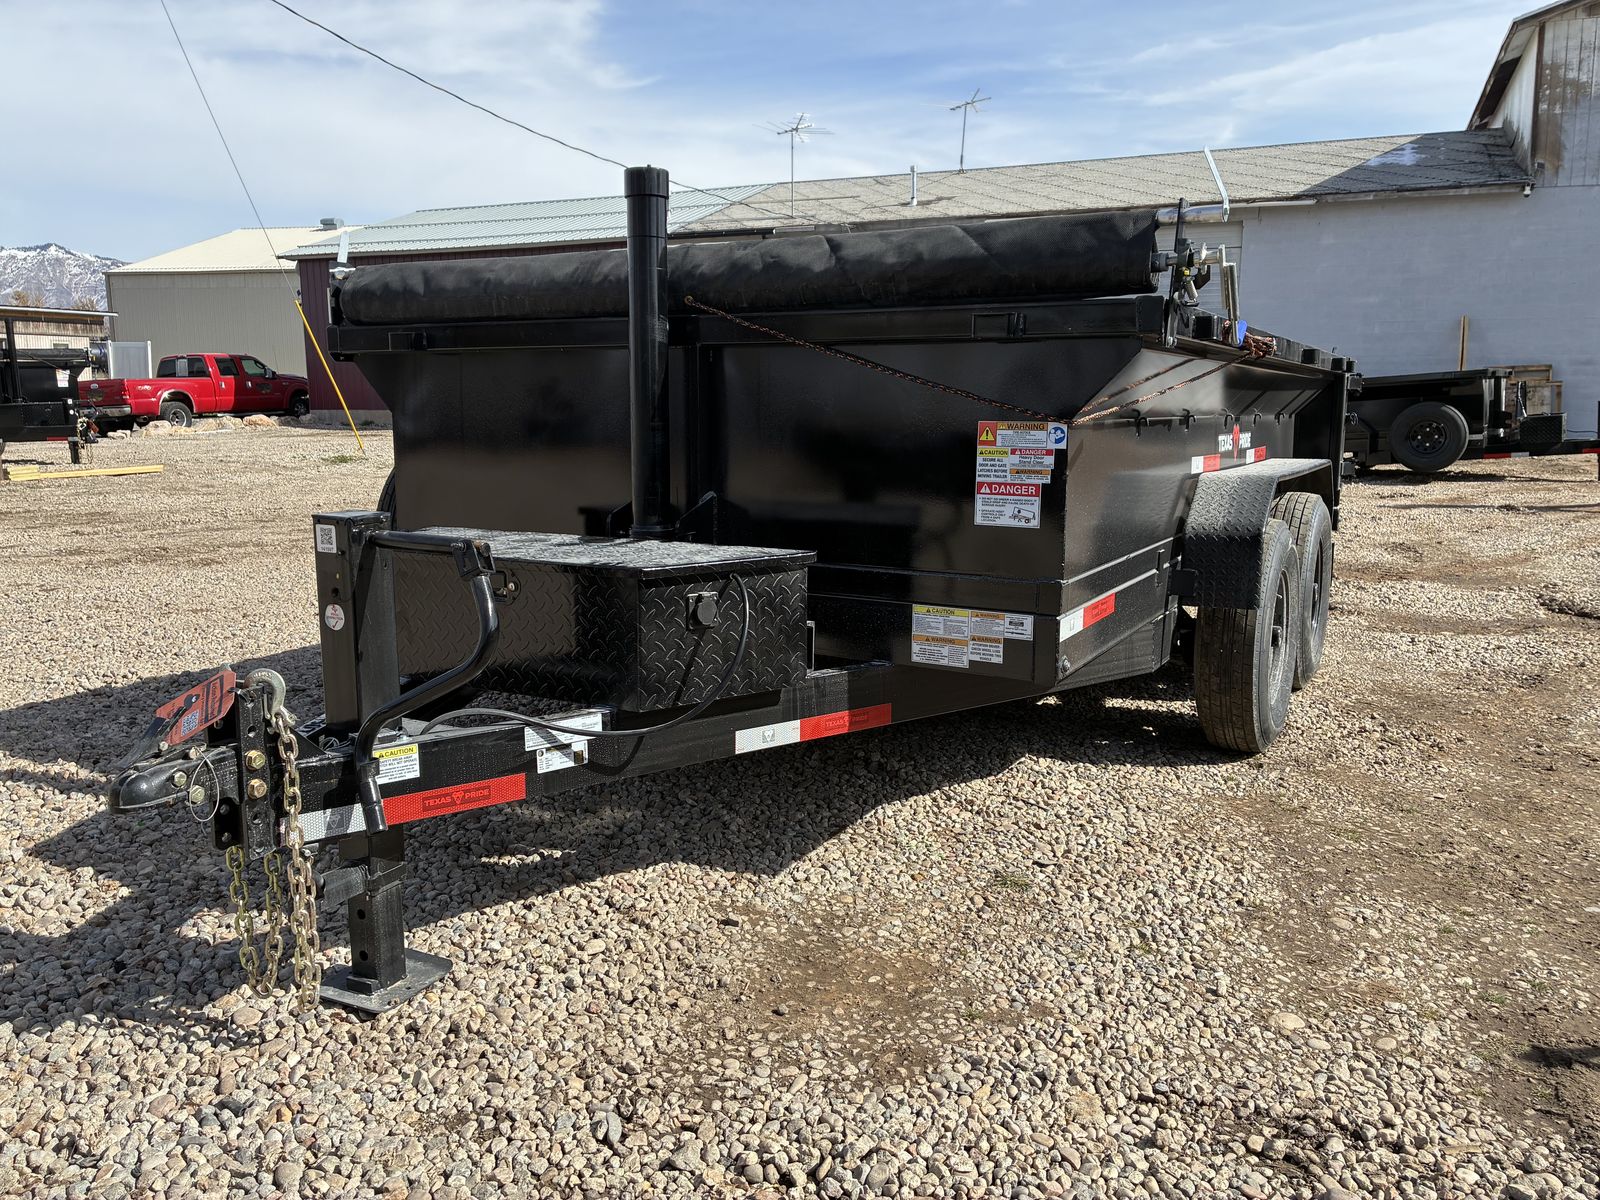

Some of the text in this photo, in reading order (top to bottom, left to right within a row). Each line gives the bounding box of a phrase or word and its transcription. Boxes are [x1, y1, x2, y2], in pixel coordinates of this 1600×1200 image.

[1007, 422, 1045, 430] WARNING
[1218, 431, 1252, 452] TEXAS PRIDE
[992, 484, 1036, 495] DANGER
[385, 748, 414, 757] CAUTION
[424, 789, 490, 807] TEXAS PRIDE
